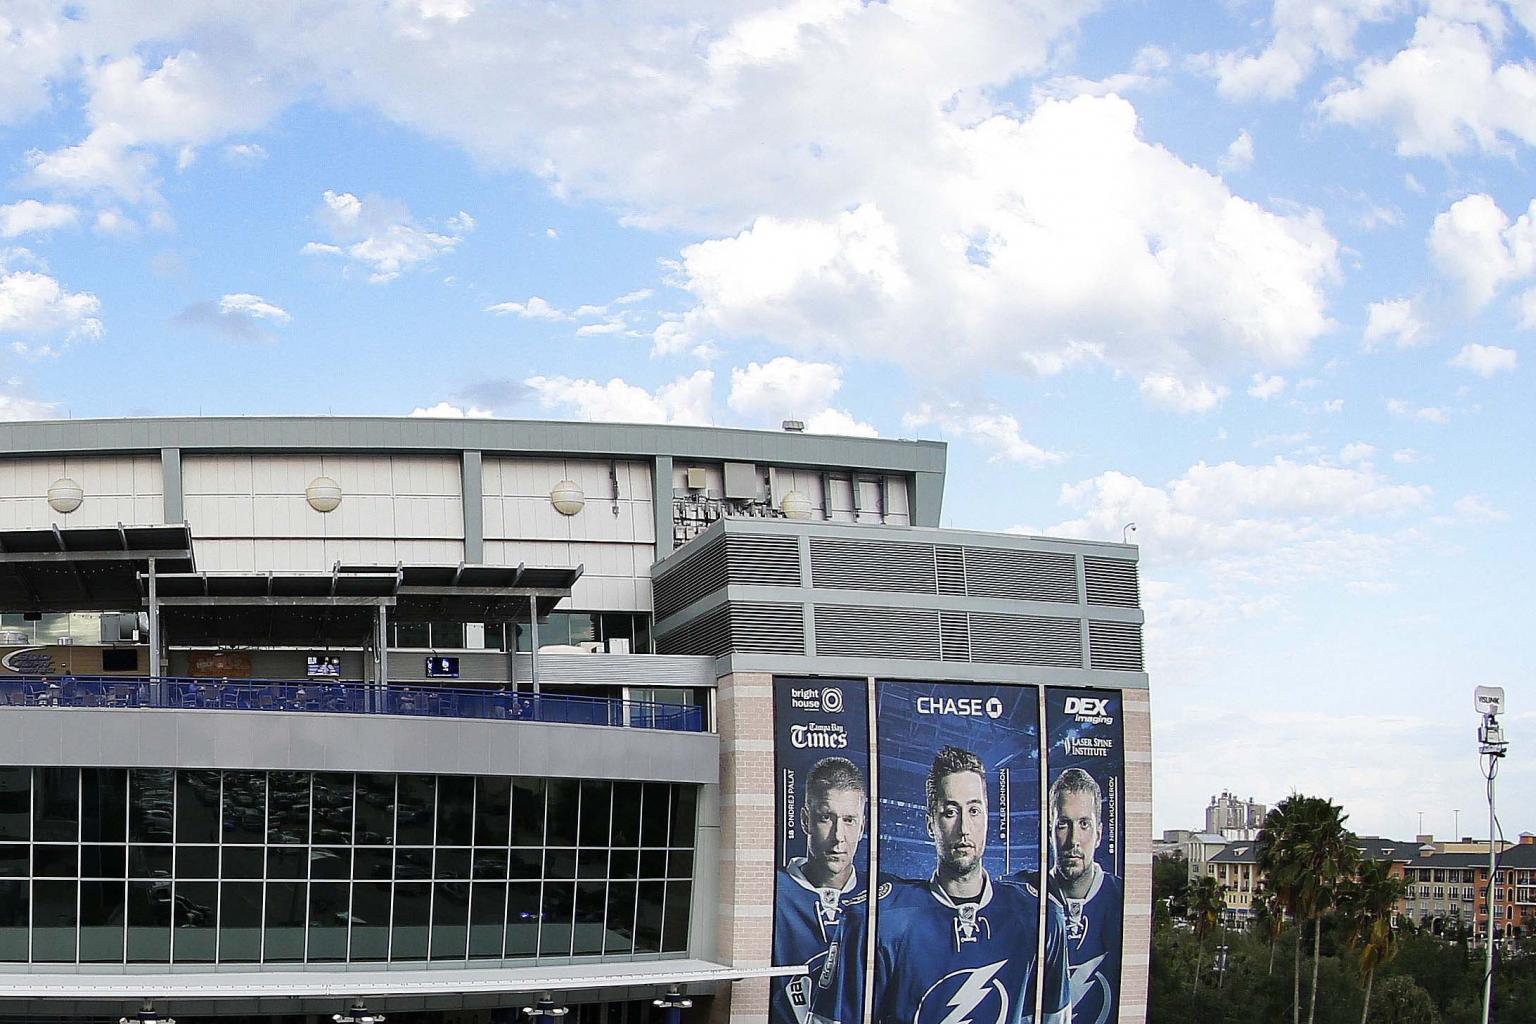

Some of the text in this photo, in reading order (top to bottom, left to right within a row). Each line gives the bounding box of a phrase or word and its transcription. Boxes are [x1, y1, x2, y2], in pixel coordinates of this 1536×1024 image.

[791, 688, 819, 699] bright
[792, 698, 820, 708] house
[917, 697, 983, 716] CHASE
[1064, 697, 1109, 716] DEX
[808, 723, 844, 733] Tampa Bay
[790, 724, 848, 749] Times
